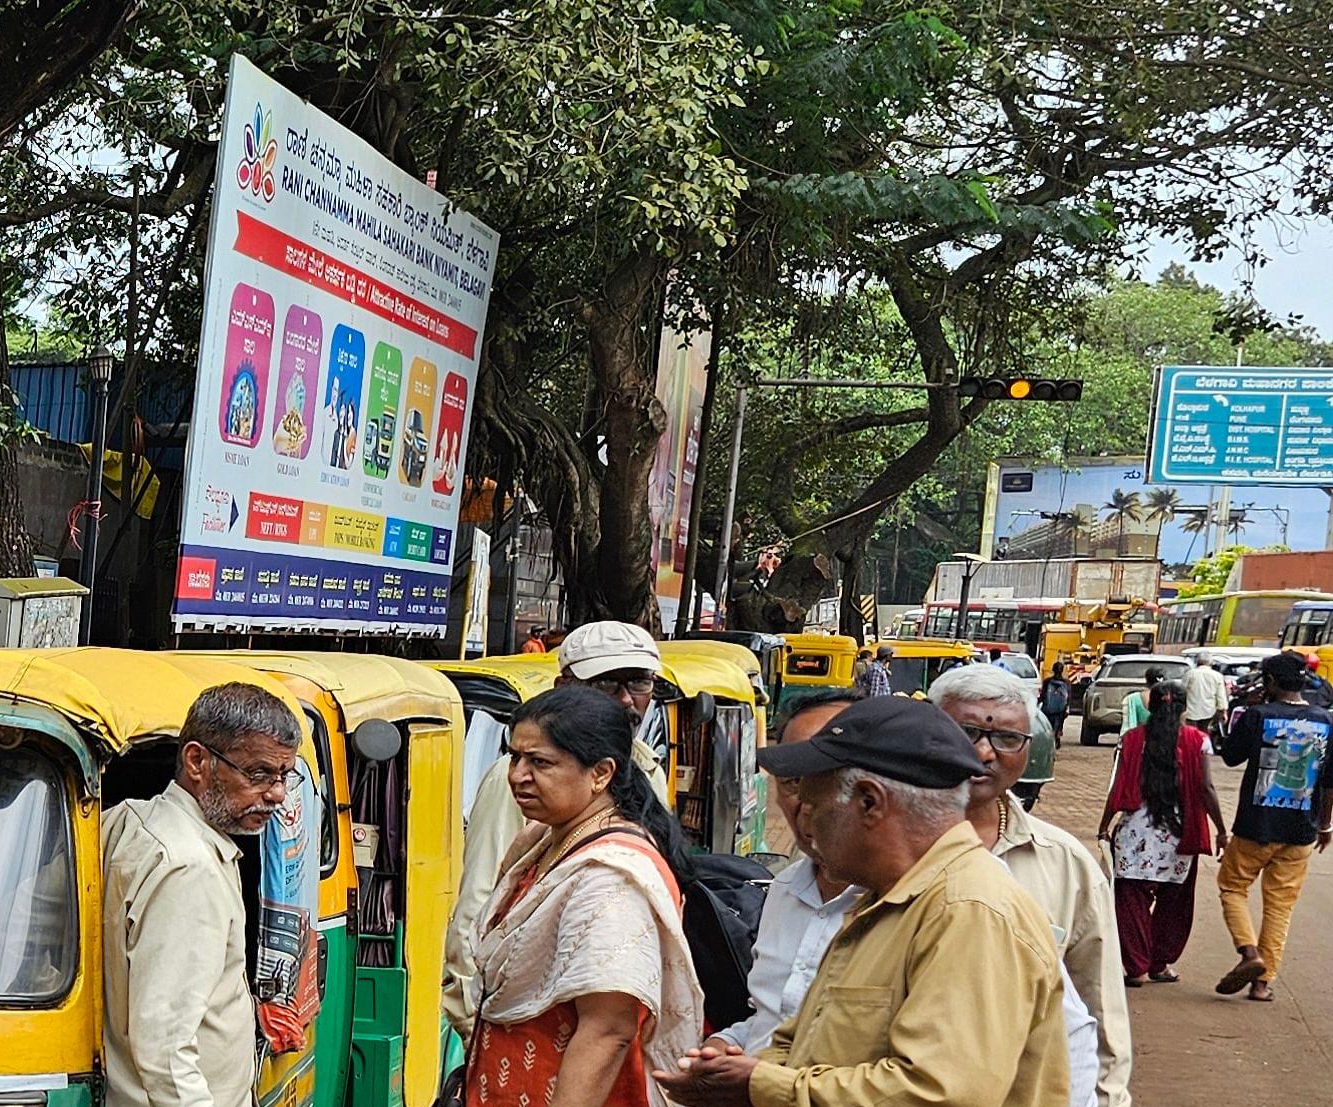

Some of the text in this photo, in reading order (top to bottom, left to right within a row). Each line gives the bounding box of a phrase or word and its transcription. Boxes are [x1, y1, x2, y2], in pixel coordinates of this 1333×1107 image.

[287, 128, 309, 160] ರಾಣಿ
[282, 166, 304, 199] RANI
[304, 179, 355, 230] CHANNAMMA
[356, 208, 383, 245] MAHILA
[383, 225, 416, 263] SAHAKARI
[415, 243, 434, 273] BANK
[459, 269, 486, 300] BELAGAVI
[370, 285, 395, 313] Attractive
[394, 297, 406, 319] Rate
[412, 305, 430, 331] Interest
[435, 318, 451, 339] Loans
[1229, 415, 1248, 423] PUNE
[1230, 405, 1266, 413] KOLHAPUR
